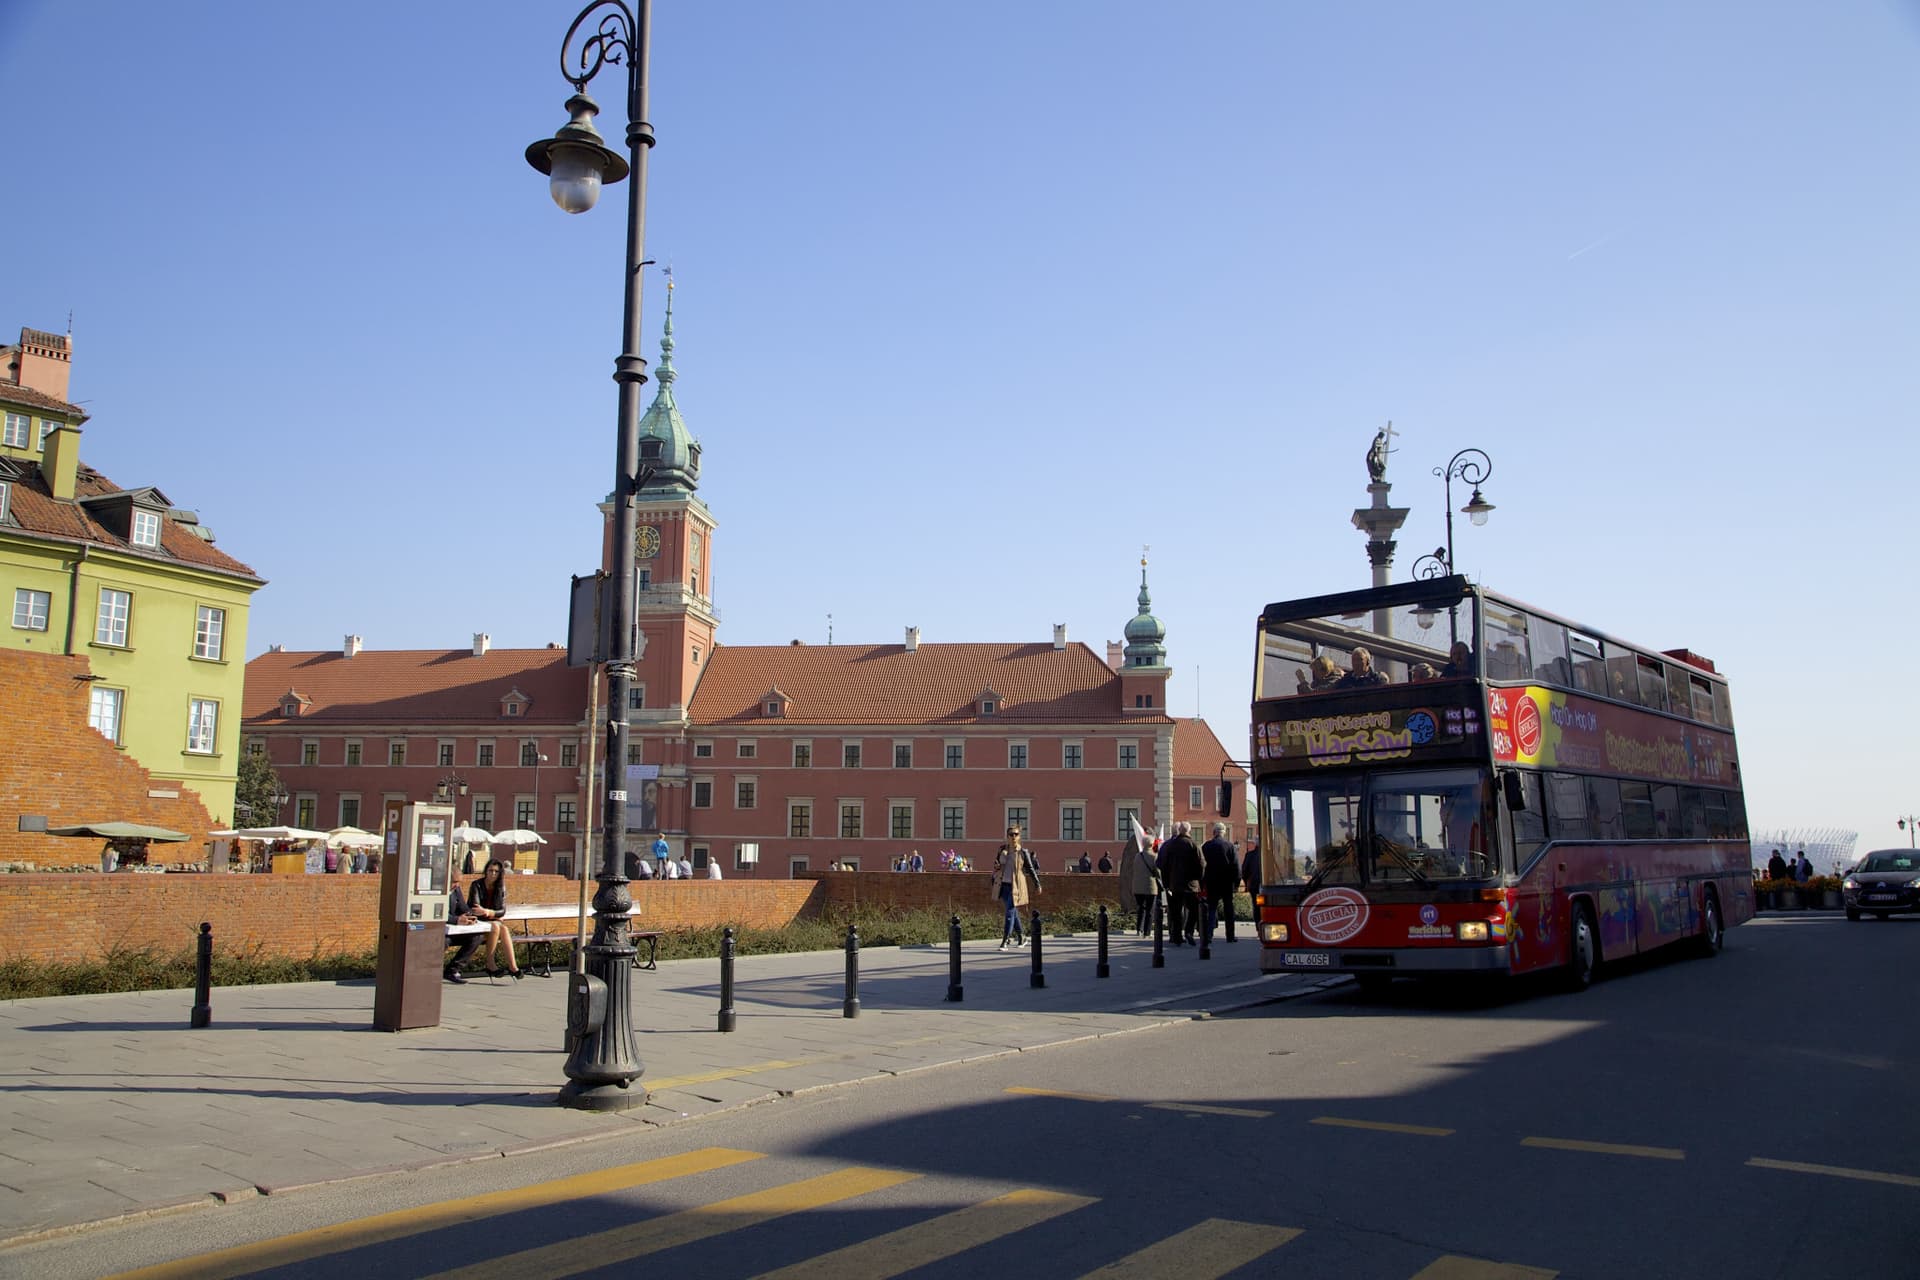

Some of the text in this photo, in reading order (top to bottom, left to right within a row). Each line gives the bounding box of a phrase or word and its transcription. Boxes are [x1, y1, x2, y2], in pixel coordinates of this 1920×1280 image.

[1305, 729, 1412, 766] Warsaw
[1493, 731, 1505, 754] 48
[389, 810, 399, 830] P
[1310, 905, 1356, 925] OFFICIAL
[1286, 954, 1304, 965] CAL
